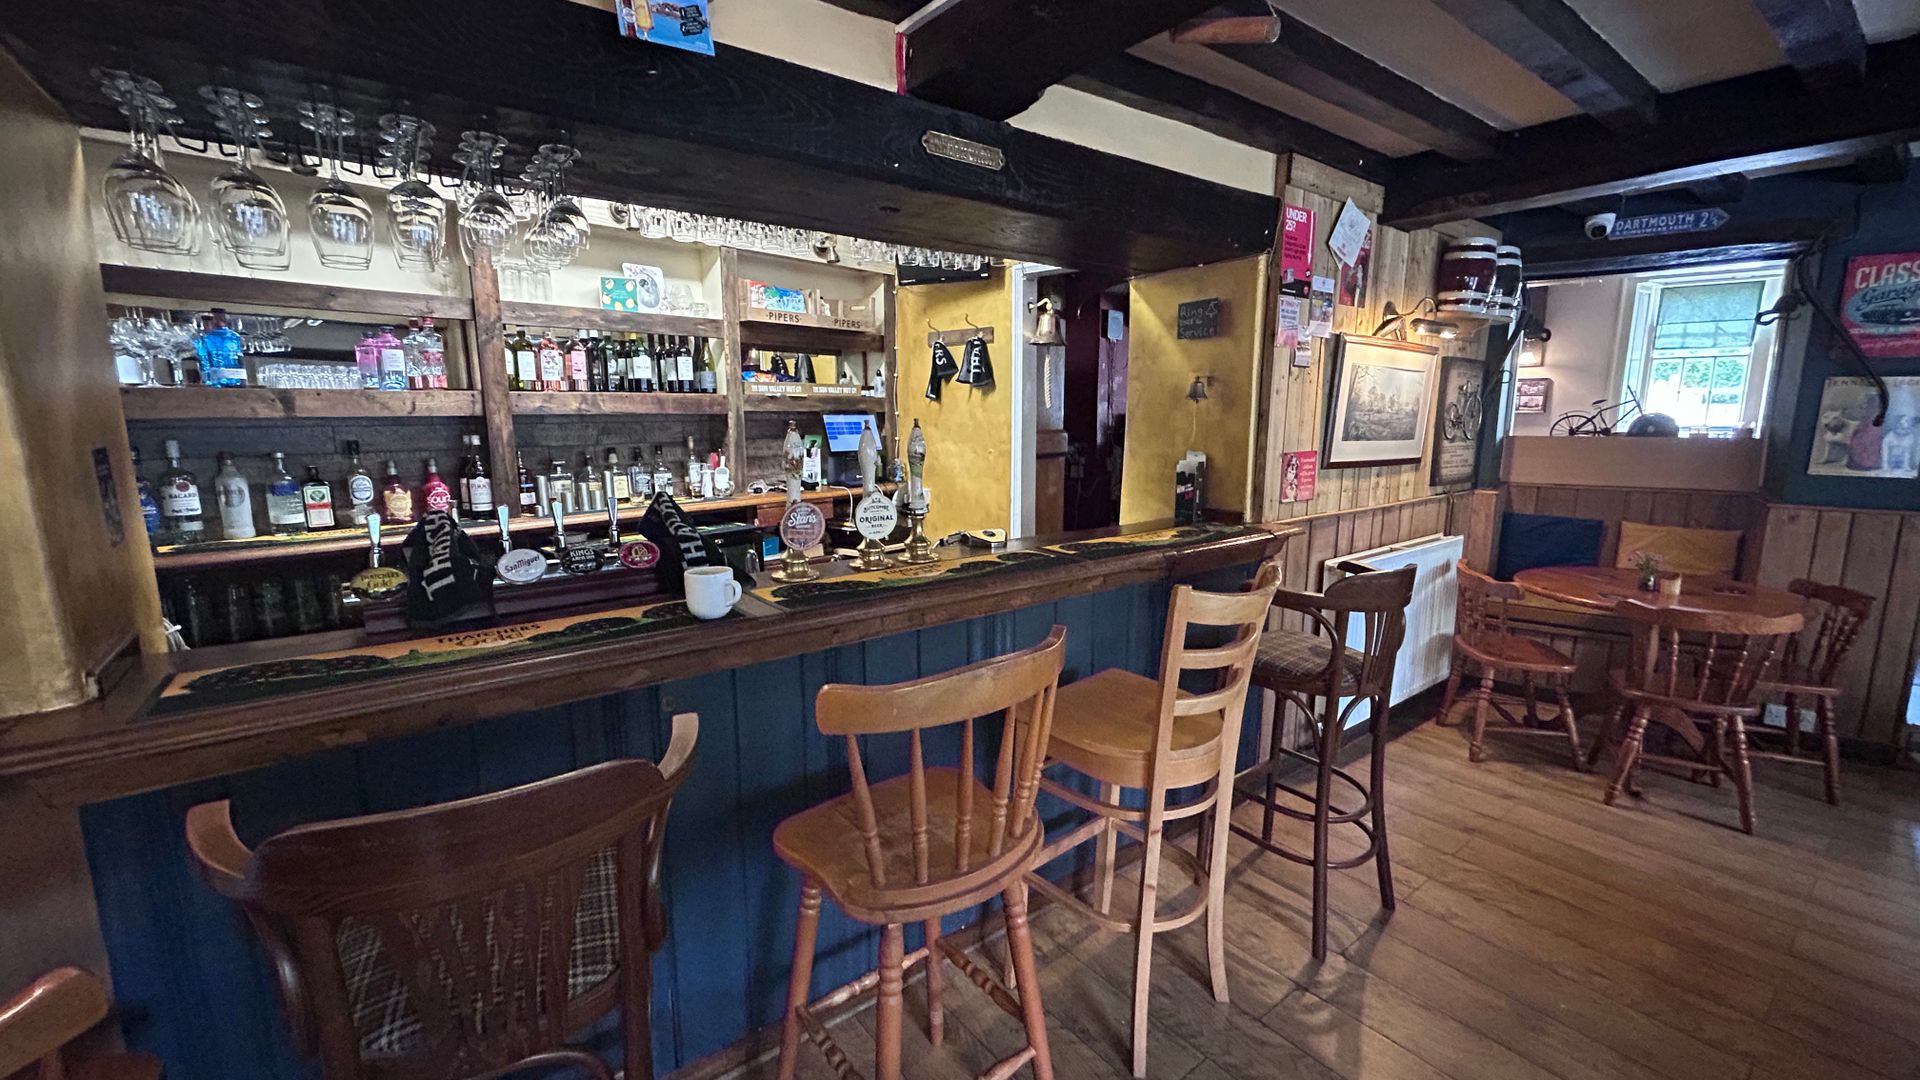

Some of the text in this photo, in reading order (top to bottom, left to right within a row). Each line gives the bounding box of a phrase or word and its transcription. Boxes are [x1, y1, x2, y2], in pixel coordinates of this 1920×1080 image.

[1286, 207, 1308, 224] UNDER
[1616, 213, 1695, 231] DARTMOUTH
[768, 311, 800, 323] PIPERS
[833, 318, 861, 329] PIPERS
[788, 512, 817, 527] Stan's
[859, 514, 894, 523] ORIGINAL
[570, 548, 595, 557] KINGS
[438, 624, 541, 643] THATCHERS
